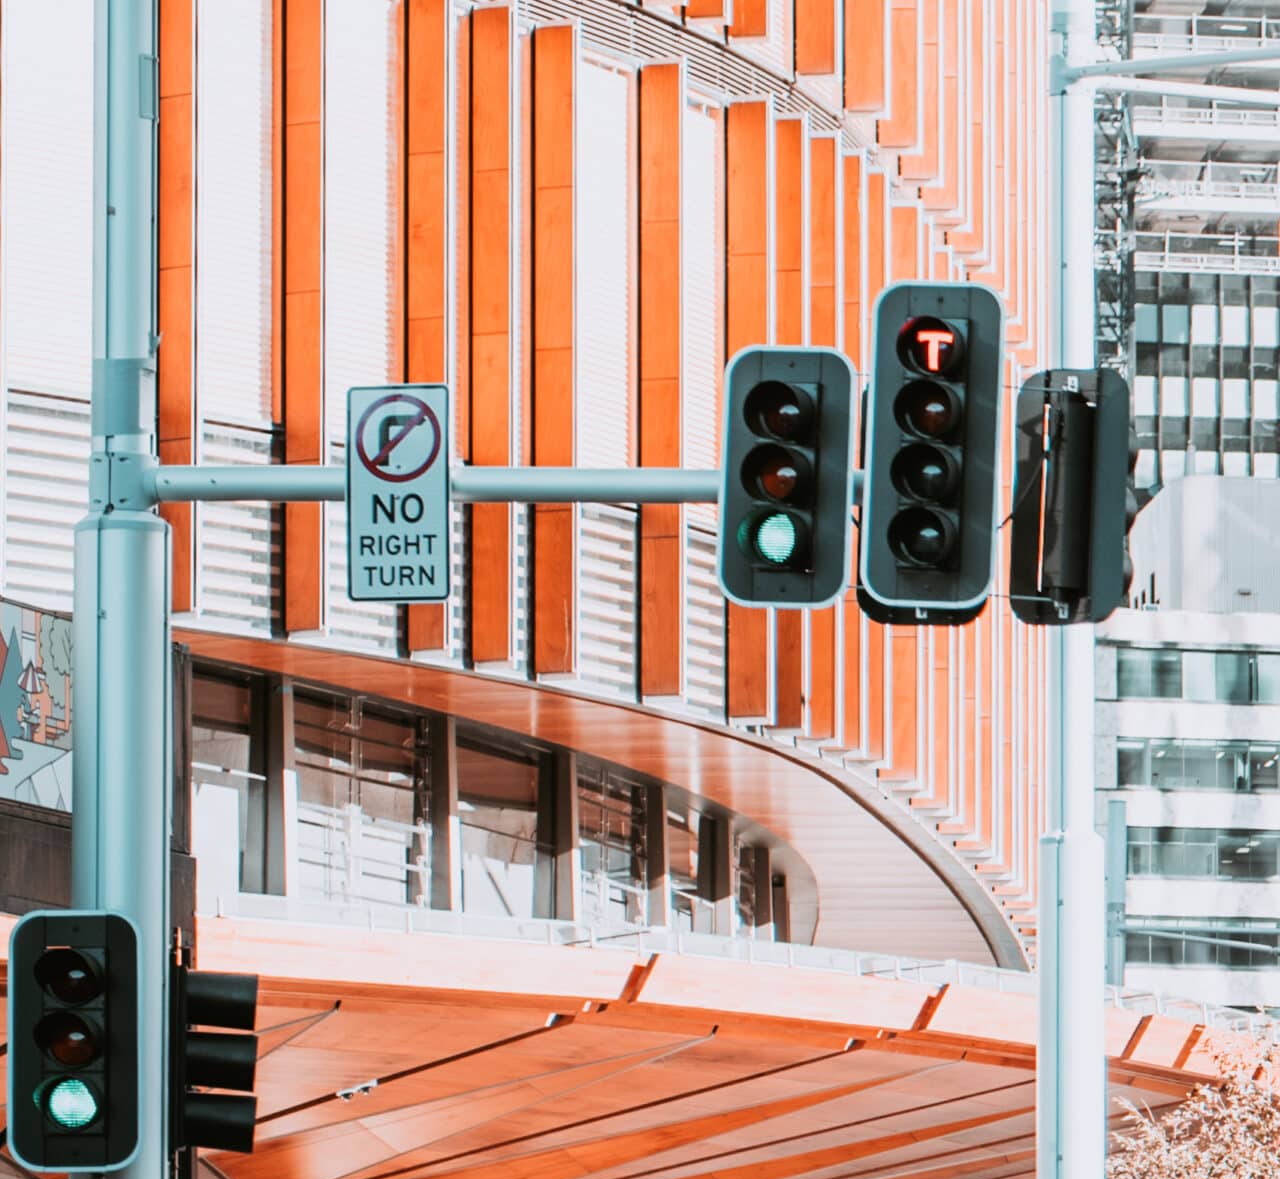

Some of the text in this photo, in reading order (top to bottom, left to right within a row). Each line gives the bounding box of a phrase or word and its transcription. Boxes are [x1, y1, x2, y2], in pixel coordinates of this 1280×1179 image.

[917, 330, 954, 371] T
[372, 493, 424, 524] NO
[360, 534, 437, 556] RIGHT
[363, 565, 435, 587] TURN
